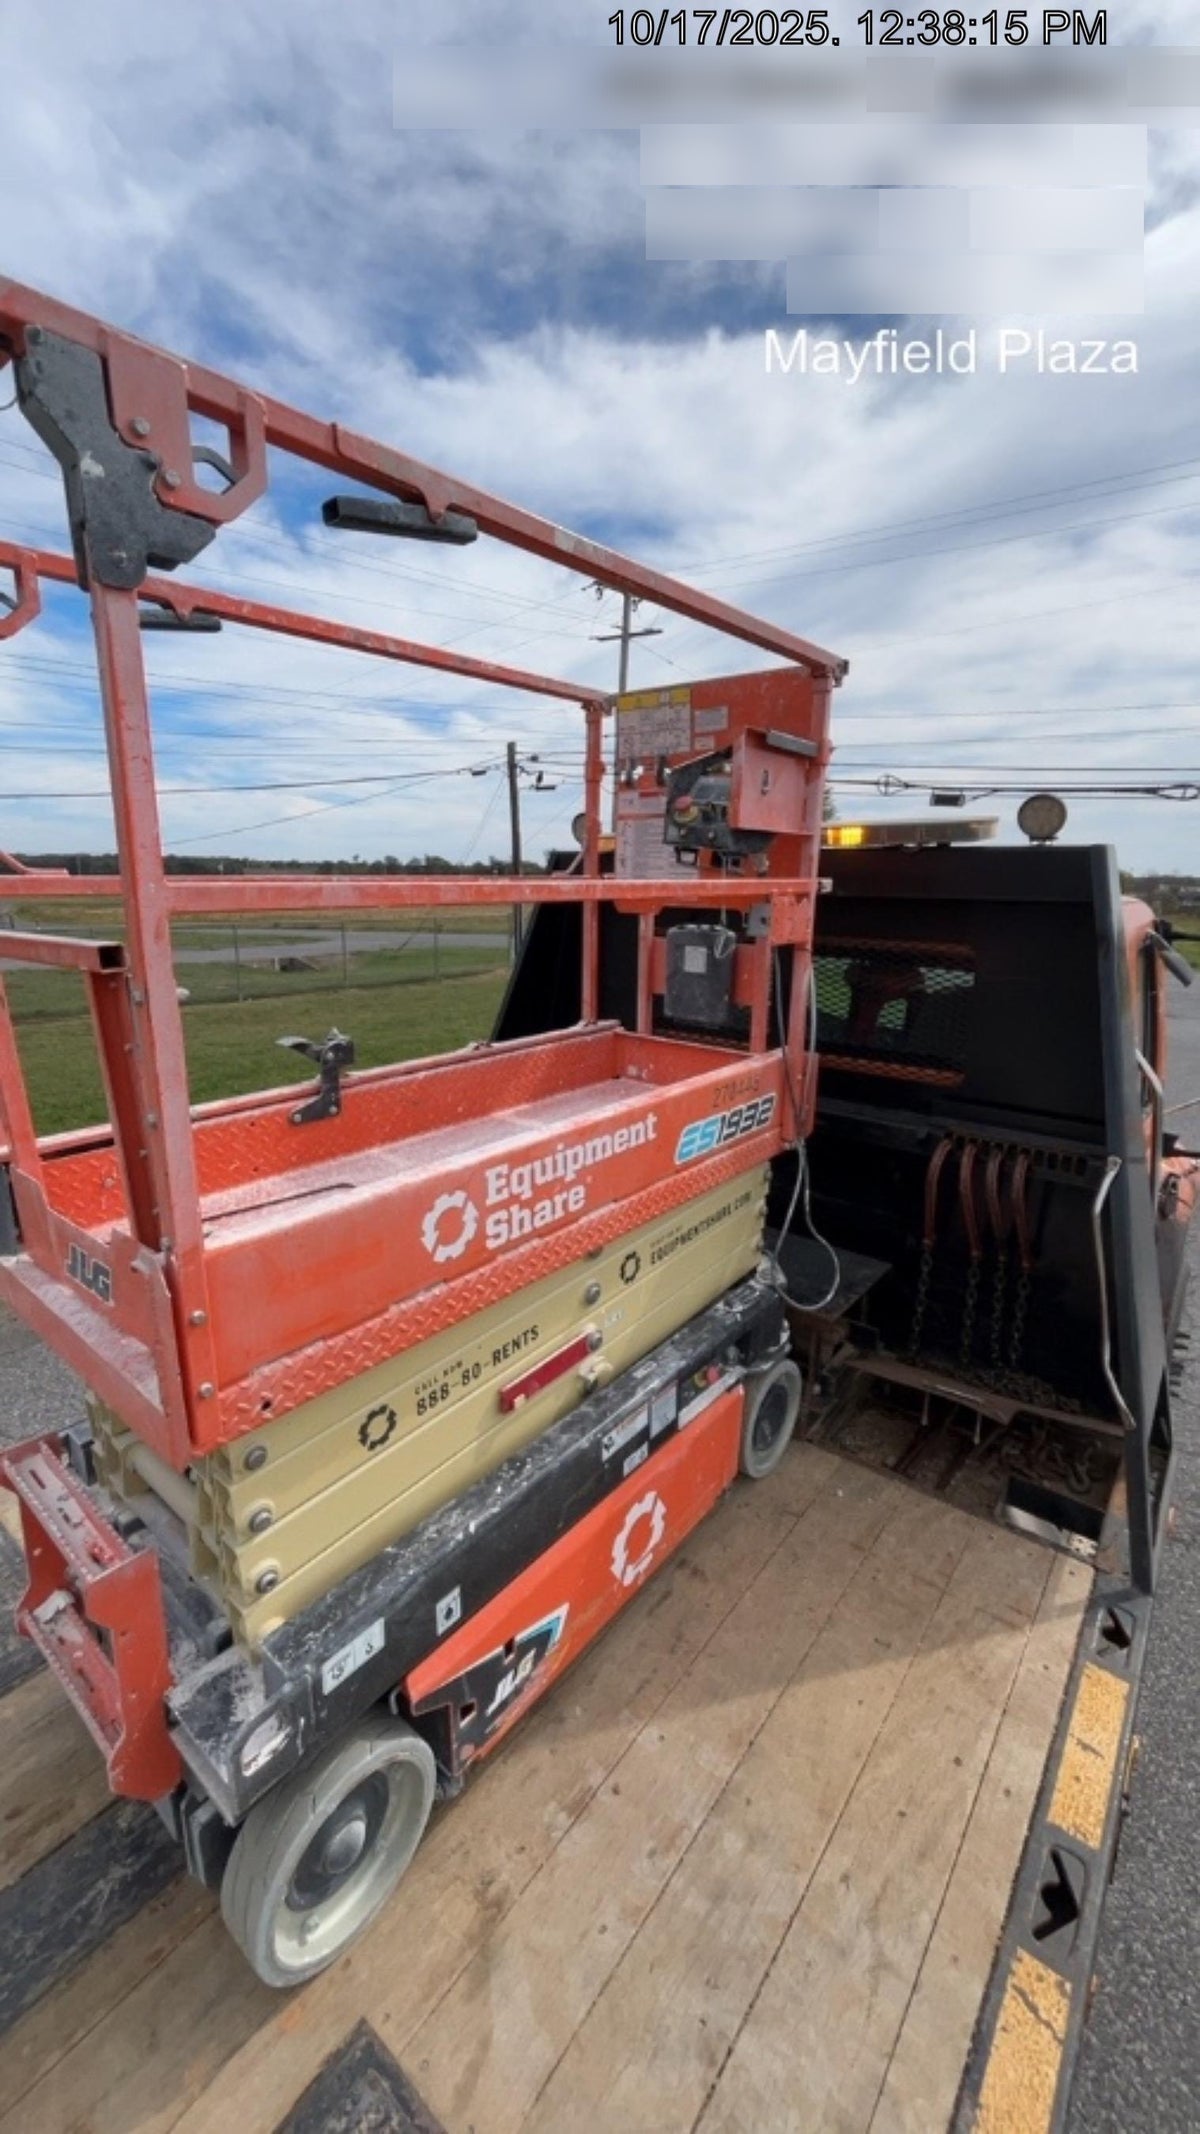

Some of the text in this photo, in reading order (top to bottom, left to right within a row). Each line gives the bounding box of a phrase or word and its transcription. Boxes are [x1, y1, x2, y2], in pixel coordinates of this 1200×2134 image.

[486, 1112, 658, 1206] Equipment
[677, 1096, 775, 1161] ES1932
[486, 1184, 586, 1249] Share
[66, 1244, 111, 1302] JLG
[416, 1324, 540, 1417] 888-80-RENTS
[485, 1647, 538, 1718] JLG
